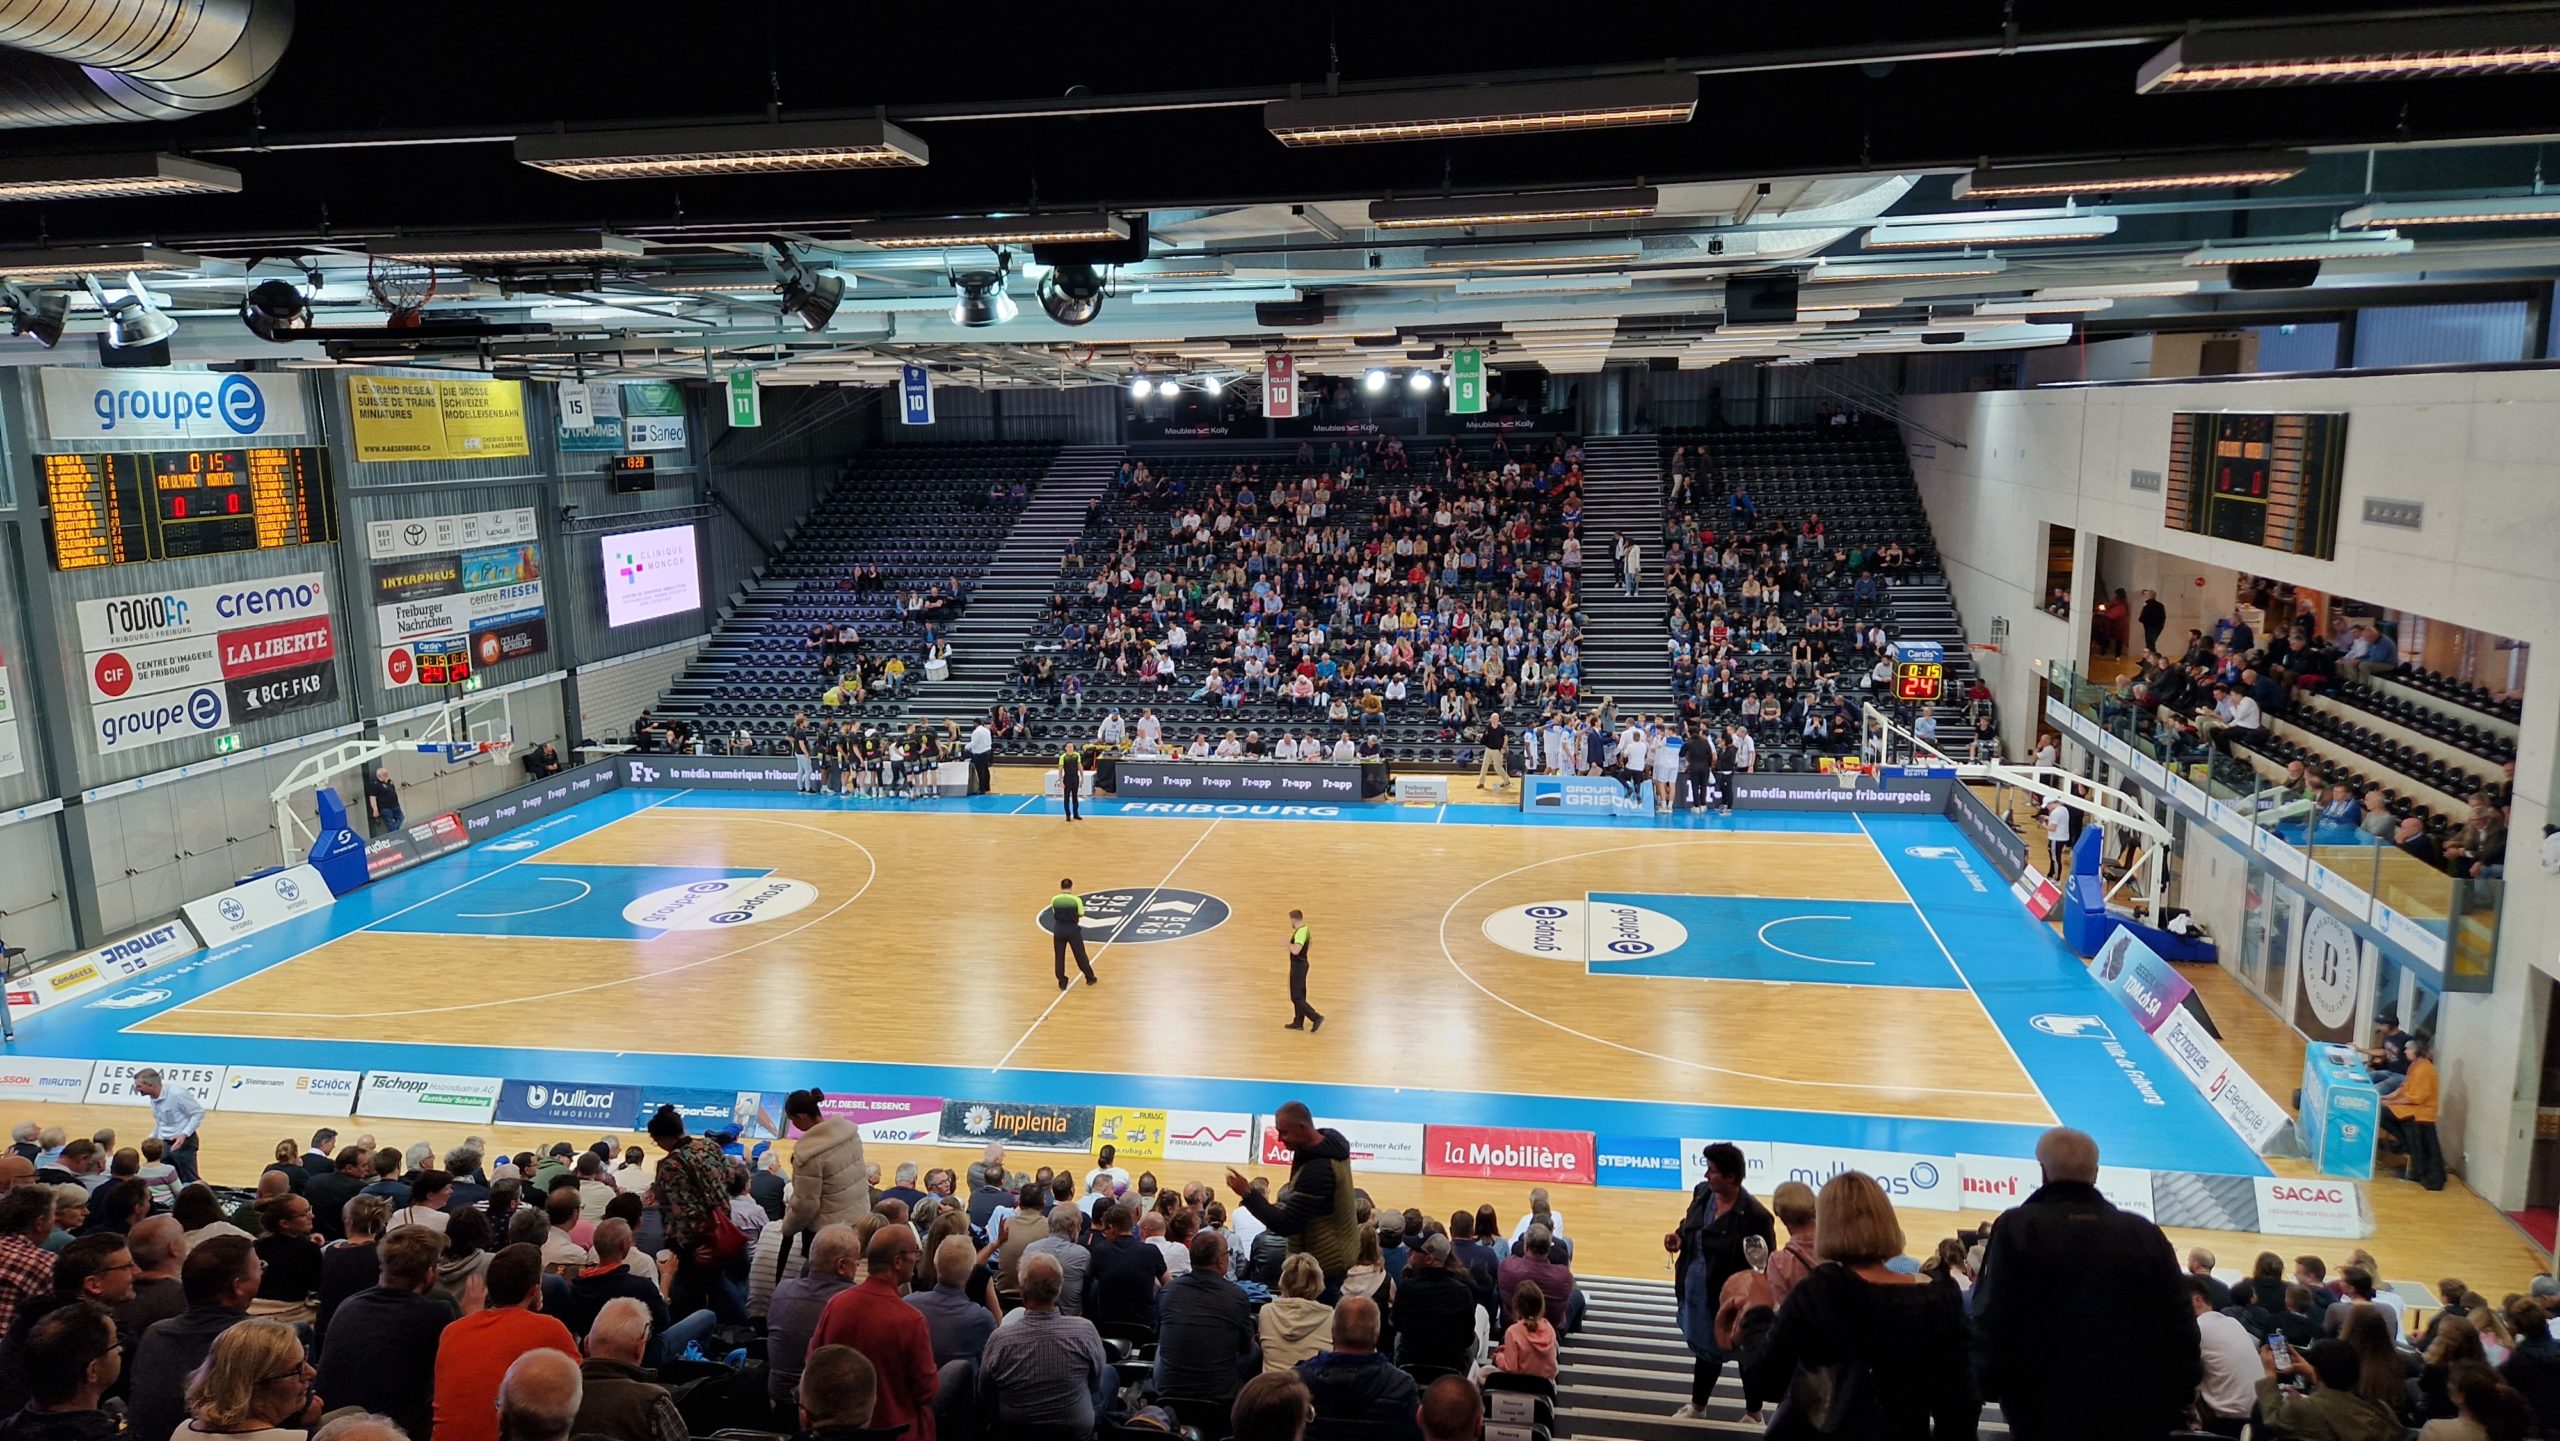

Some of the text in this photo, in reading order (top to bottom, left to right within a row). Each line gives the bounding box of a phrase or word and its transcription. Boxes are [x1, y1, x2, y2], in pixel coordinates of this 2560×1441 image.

[356, 384, 368, 394] LE
[442, 387, 489, 397] DIE GROSSE
[1272, 387, 1288, 403] 10
[1463, 382, 1473, 399] 9
[94, 387, 213, 430] groupe
[358, 397, 436, 408] SUISSE DE TRAINS
[443, 399, 489, 408] SCHWEIZER
[568, 400, 583, 415] 15
[737, 397, 749, 414] 11
[909, 395, 924, 411] 10
[359, 410, 413, 419] MINIATURES
[445, 409, 519, 419] MODELLEISENBAHN
[1165, 426, 1229, 435] Meubles Kolly
[1313, 424, 1379, 434] Meubles Kolly
[1515, 420, 1534, 429] Kolly
[506, 435, 514, 443] DE
[649, 425, 684, 442] Saneo
[364, 445, 431, 453] WWW.KAESERBERG.CH
[173, 497, 187, 518] 0
[227, 493, 240, 514] 0
[464, 522, 476, 530] BER
[518, 515, 529, 523] BER
[519, 522, 530, 531] SET
[377, 530, 391, 539] BER
[438, 524, 450, 532] BER
[465, 530, 477, 538] SET
[486, 527, 511, 537] LEXUS
[378, 538, 391, 547] SET
[439, 532, 451, 541] SET
[640, 546, 683, 559] CLINIQUE
[648, 557, 684, 569] MONCOR
[382, 569, 456, 590] INTERPNEUS
[215, 584, 313, 618] cremo
[470, 582, 539, 606] centre RIESEN
[396, 603, 444, 619] Freiburger
[397, 615, 453, 633] Nachrichten
[111, 626, 192, 644] FRIBOURG FREIBURG
[227, 627, 328, 666] LA LIBERTÉ
[1907, 650, 1934, 658] Cardis
[136, 650, 213, 671] CENTRE D'IMAGERIE
[393, 662, 407, 673] CIF
[104, 668, 124, 683] CIF
[137, 664, 190, 681] DE FRIBOURG
[1908, 665, 1940, 677] 0:15
[1905, 678, 1933, 695] 24
[102, 704, 184, 745] groupe
[670, 767, 763, 782] le média numérique
[1566, 785, 1617, 795] GROUPE
[1737, 787, 1931, 802] le média numérique fribourgeois
[1120, 802, 1340, 817] FRIBOURG
[286, 899, 309, 910] HYDRO
[738, 883, 791, 911] groupe
[642, 893, 701, 922] groupe
[229, 919, 253, 931] HYDRO
[1610, 908, 1640, 940] groupe
[1533, 918, 1562, 952] groupe
[100, 926, 177, 964] JAQUET
[2321, 940, 2338, 987] B
[51, 966, 94, 986] Condecta
[2123, 975, 2153, 1008] TDM.ch
[2146, 999, 2162, 1018] SA
[2117, 1057, 2137, 1072] de
[104, 1066, 214, 1083] LES ARTES
[99, 1083, 121, 1095] DE
[245, 1078, 284, 1087] Steinemann
[311, 1078, 352, 1090] SCHÖCK
[371, 1075, 494, 1094] Tschopp Holzindustrie AG
[2125, 1068, 2165, 1105] Fribourg
[551, 1089, 614, 1109] bulliard
[838, 1100, 911, 1111] DIESEL, ESSENCE
[549, 1110, 610, 1118] IMMOBILIER
[2224, 1084, 2265, 1130] Electricité
[994, 1111, 1068, 1135] Implenia
[1139, 1112, 1163, 1120] RUBAG
[873, 1130, 908, 1140] VARO
[1170, 1139, 1212, 1147] FIRMANN
[1350, 1140, 1412, 1151] ebrunner Acifer
[1444, 1142, 1576, 1170] la Mobilière
[1597, 1154, 1660, 1169] STEPHAN
[1963, 1175, 2019, 1196] naef
[2272, 1185, 2343, 1204] SACAC
